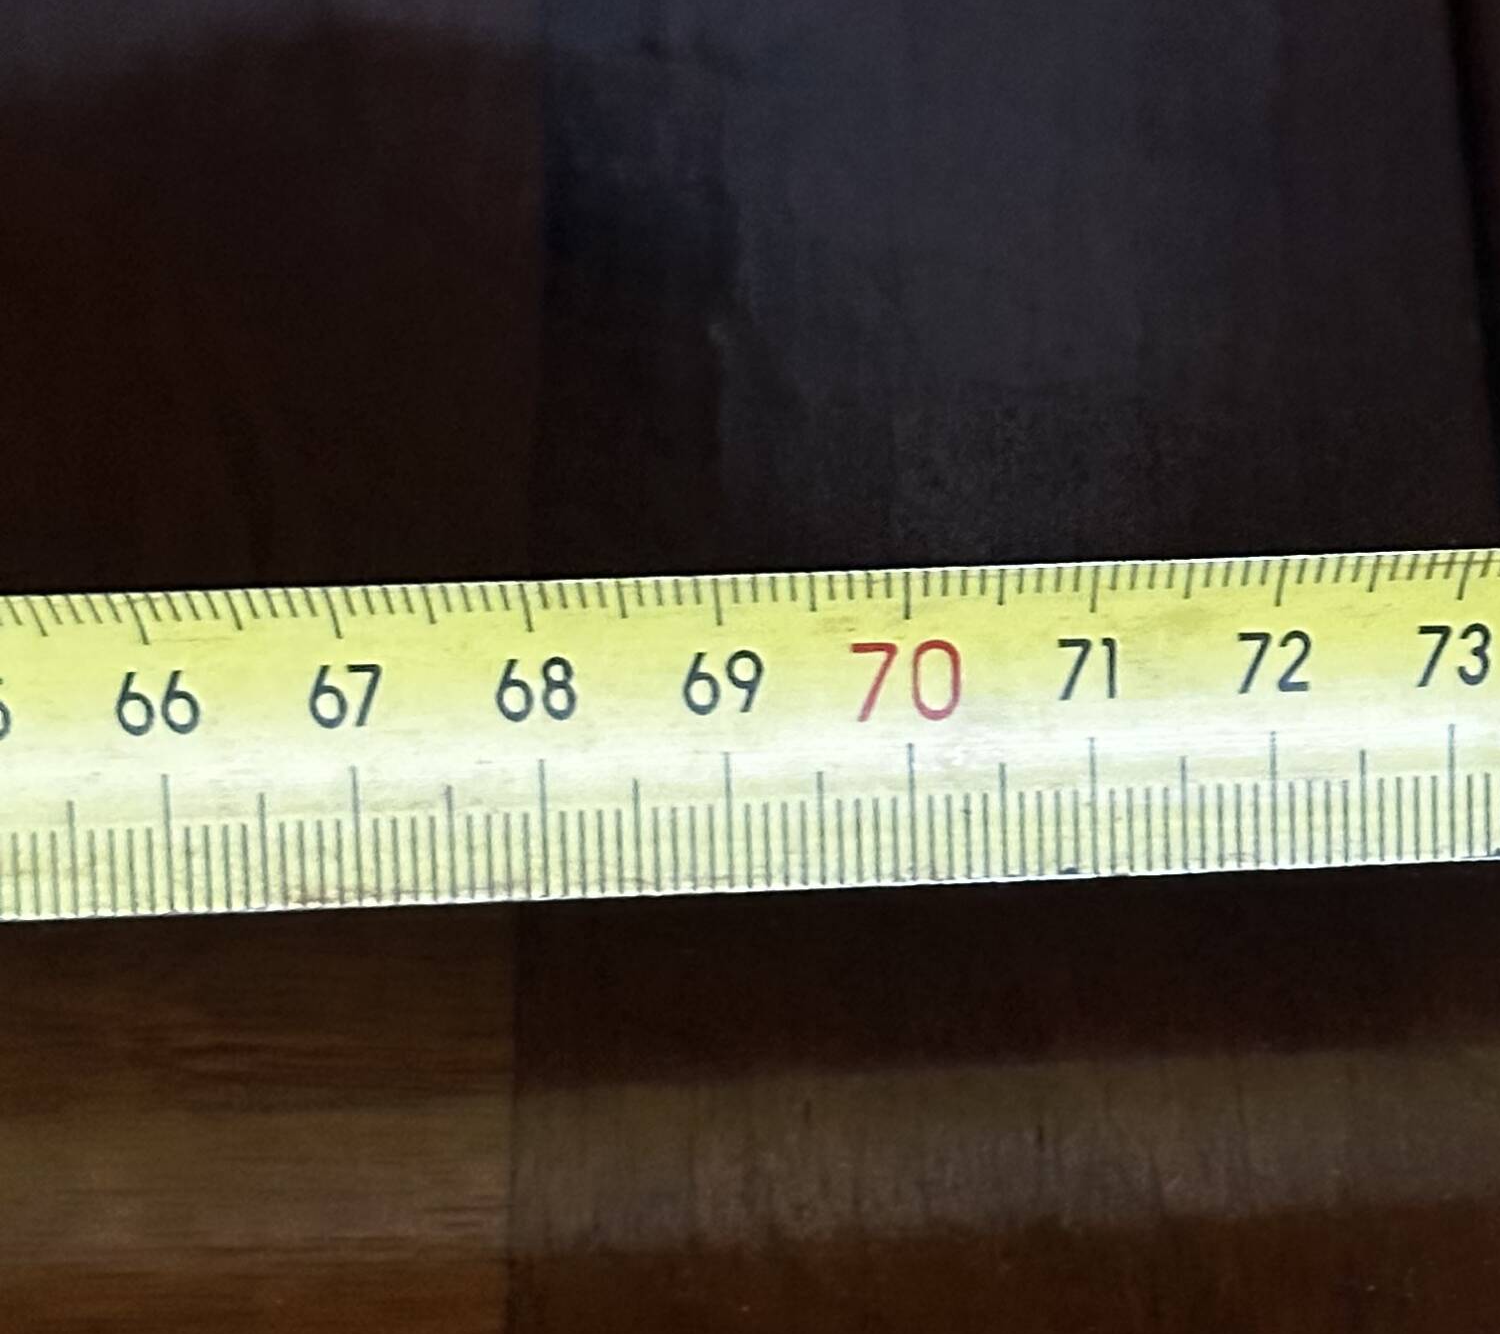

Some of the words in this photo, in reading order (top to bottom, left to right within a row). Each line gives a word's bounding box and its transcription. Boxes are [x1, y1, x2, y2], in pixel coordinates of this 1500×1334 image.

[115, 670, 201, 736] 66
[308, 664, 382, 729] 67
[495, 656, 577, 722] 68
[682, 649, 764, 716] 69
[850, 639, 961, 722] 70
[1057, 637, 1118, 701] 71
[1237, 630, 1312, 695] 72
[1416, 622, 1492, 687] 73
